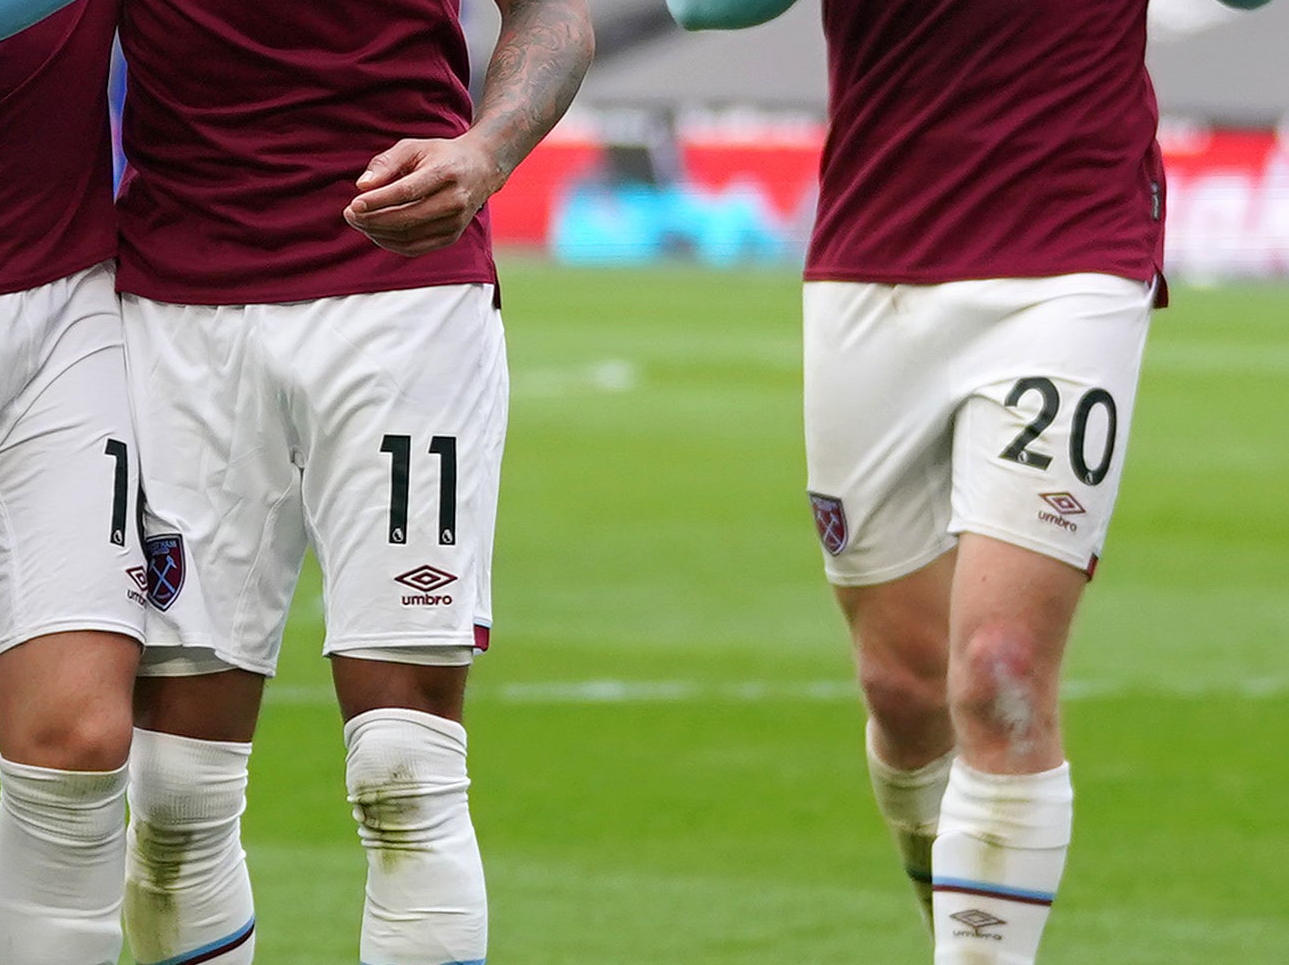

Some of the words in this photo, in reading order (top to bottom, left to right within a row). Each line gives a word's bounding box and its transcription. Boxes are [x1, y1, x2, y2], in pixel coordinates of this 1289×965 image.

[998, 375, 1118, 487] 20
[379, 434, 458, 546] 11
[1037, 509, 1078, 532] umbro
[401, 593, 453, 606] umbro
[952, 930, 1003, 942] umro
